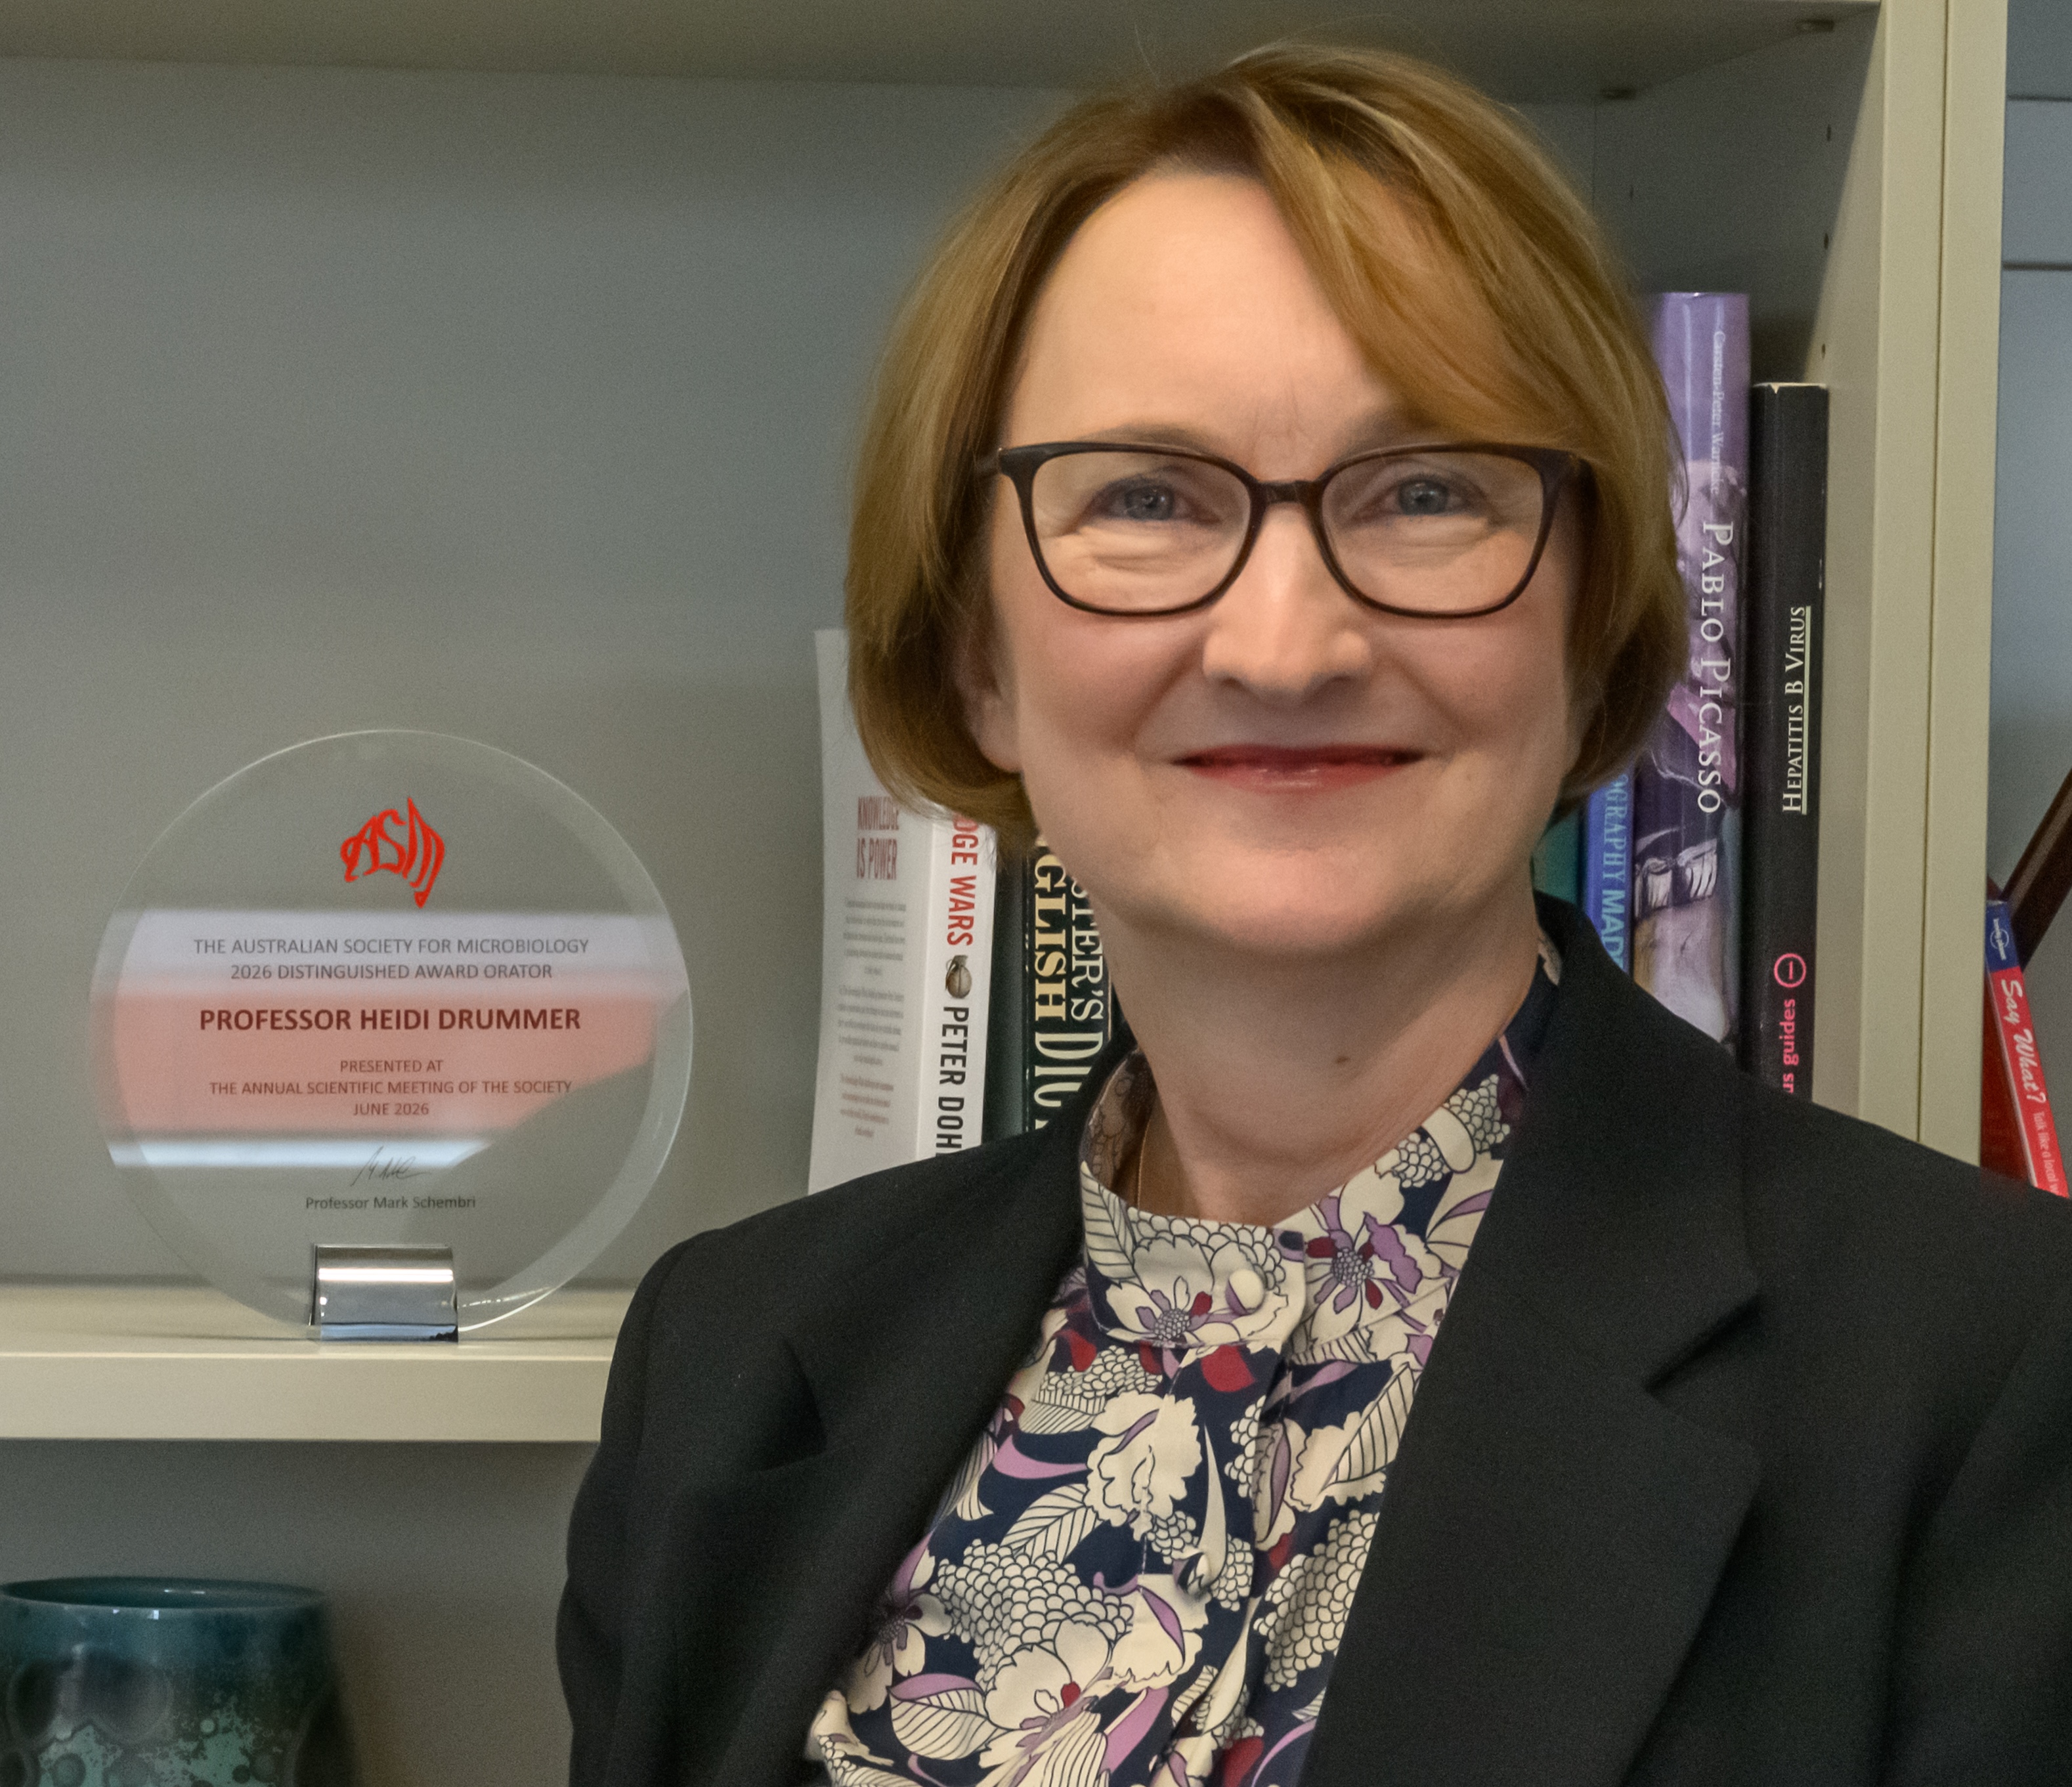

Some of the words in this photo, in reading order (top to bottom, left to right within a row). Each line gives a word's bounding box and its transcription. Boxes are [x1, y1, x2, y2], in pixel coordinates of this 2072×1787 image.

[1700, 521, 1734, 643] PABLO
[1785, 606, 1806, 672] VIRUS
[1784, 679, 1803, 694] B
[1696, 656, 1732, 813] PICASSO
[1782, 704, 1803, 813] HEPATITIS
[340, 796, 445, 909] ASM
[857, 838, 866, 879] IS
[868, 838, 897, 880] POWER
[947, 875, 977, 946] WARS
[1034, 836, 1067, 1022] GLISH
[194, 939, 226, 954] THE
[232, 939, 338, 953] AUSTRALIAN
[343, 939, 413, 953] SOCIETY
[418, 939, 452, 953] FOR
[458, 939, 589, 953] MICROBIOLOGY
[231, 964, 272, 980] 2026
[278, 964, 410, 979] DISTINGUISHED
[414, 964, 479, 979] AWARD
[484, 964, 552, 978] ORATOR
[200, 1009, 351, 1031] PROFESSOR
[361, 1009, 429, 1030] HEIDI
[439, 1008, 580, 1029] DRUMMER
[939, 1006, 970, 1086] PETER
[1779, 999, 1800, 1066] guides
[2001, 979, 2023, 1025] Say
[2013, 1028, 2046, 1104] What?
[210, 1082, 237, 1095] THE
[241, 1082, 303, 1094] ANNUAL
[307, 1082, 383, 1094] SCIENTIFIC
[387, 1081, 454, 1094] MEETING
[458, 1081, 478, 1094] OF
[481, 1081, 509, 1093] THE
[513, 1081, 572, 1093] SOCIETY
[340, 1060, 422, 1073] PRESENTED
[426, 1060, 444, 1073] AT
[1033, 1031, 1104, 1130] DIC
[353, 1103, 389, 1115] JUNE
[394, 1103, 429, 1115] 2026
[935, 1096, 965, 1157] DOH
[305, 1196, 369, 1209] Professor
[373, 1196, 408, 1209] Mark
[412, 1195, 476, 1209] Schembri
